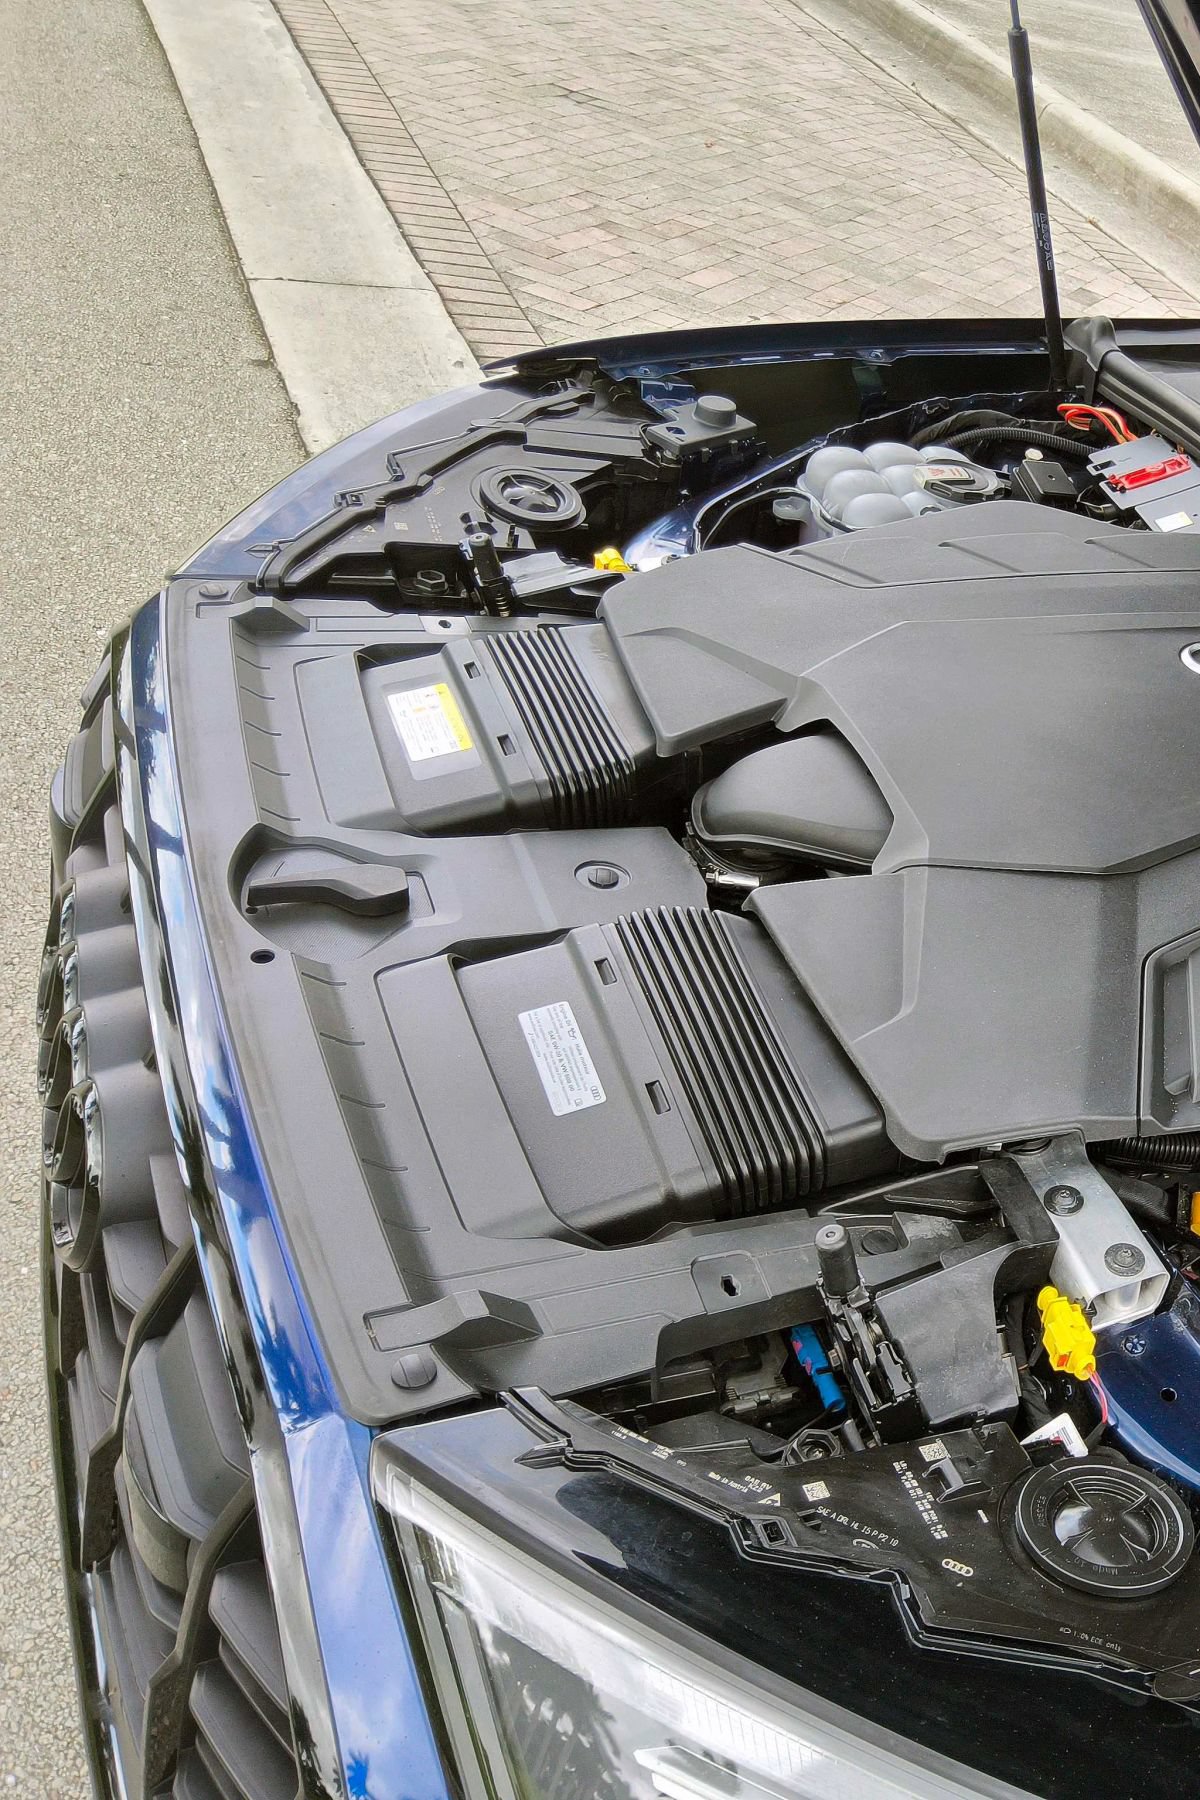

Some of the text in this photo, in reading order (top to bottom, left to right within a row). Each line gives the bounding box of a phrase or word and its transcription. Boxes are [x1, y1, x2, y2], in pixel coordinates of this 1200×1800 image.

[727, 1480, 749, 1493] Austria
[816, 1506, 831, 1517] SAE
[878, 1533, 888, 1542] P2
[1090, 1636, 1103, 1645] ECE
[1106, 1642, 1121, 1652] only
